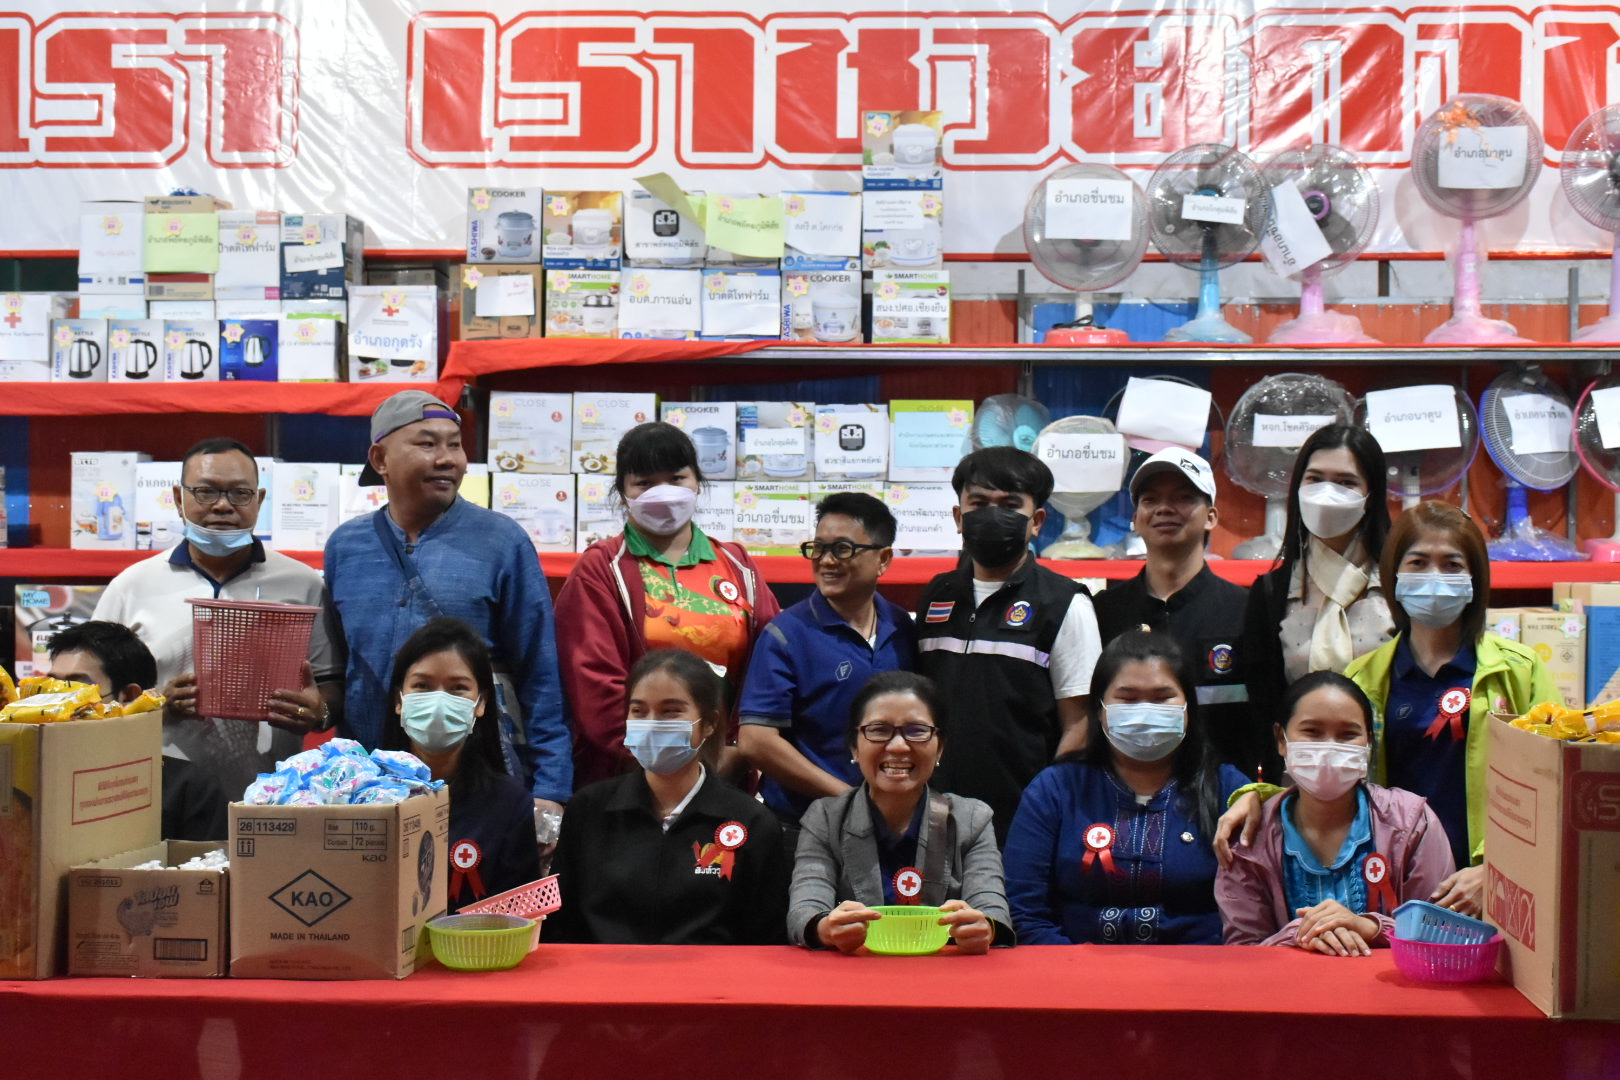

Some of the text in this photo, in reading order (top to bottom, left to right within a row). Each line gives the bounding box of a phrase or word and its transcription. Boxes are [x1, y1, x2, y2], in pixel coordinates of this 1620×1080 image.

[809, 274, 851, 283] COOKER
[783, 303, 791, 340] ASHIWA
[353, 330, 423, 353] อำเภอกุดรัง
[1384, 409, 1443, 424] อำเภอนาดูน
[256, 822, 295, 832] 113429
[355, 822, 368, 832] 110
[354, 837, 364, 847] 72
[291, 891, 334, 907] KAO
[270, 932, 351, 942] MADE IN THAILAND
